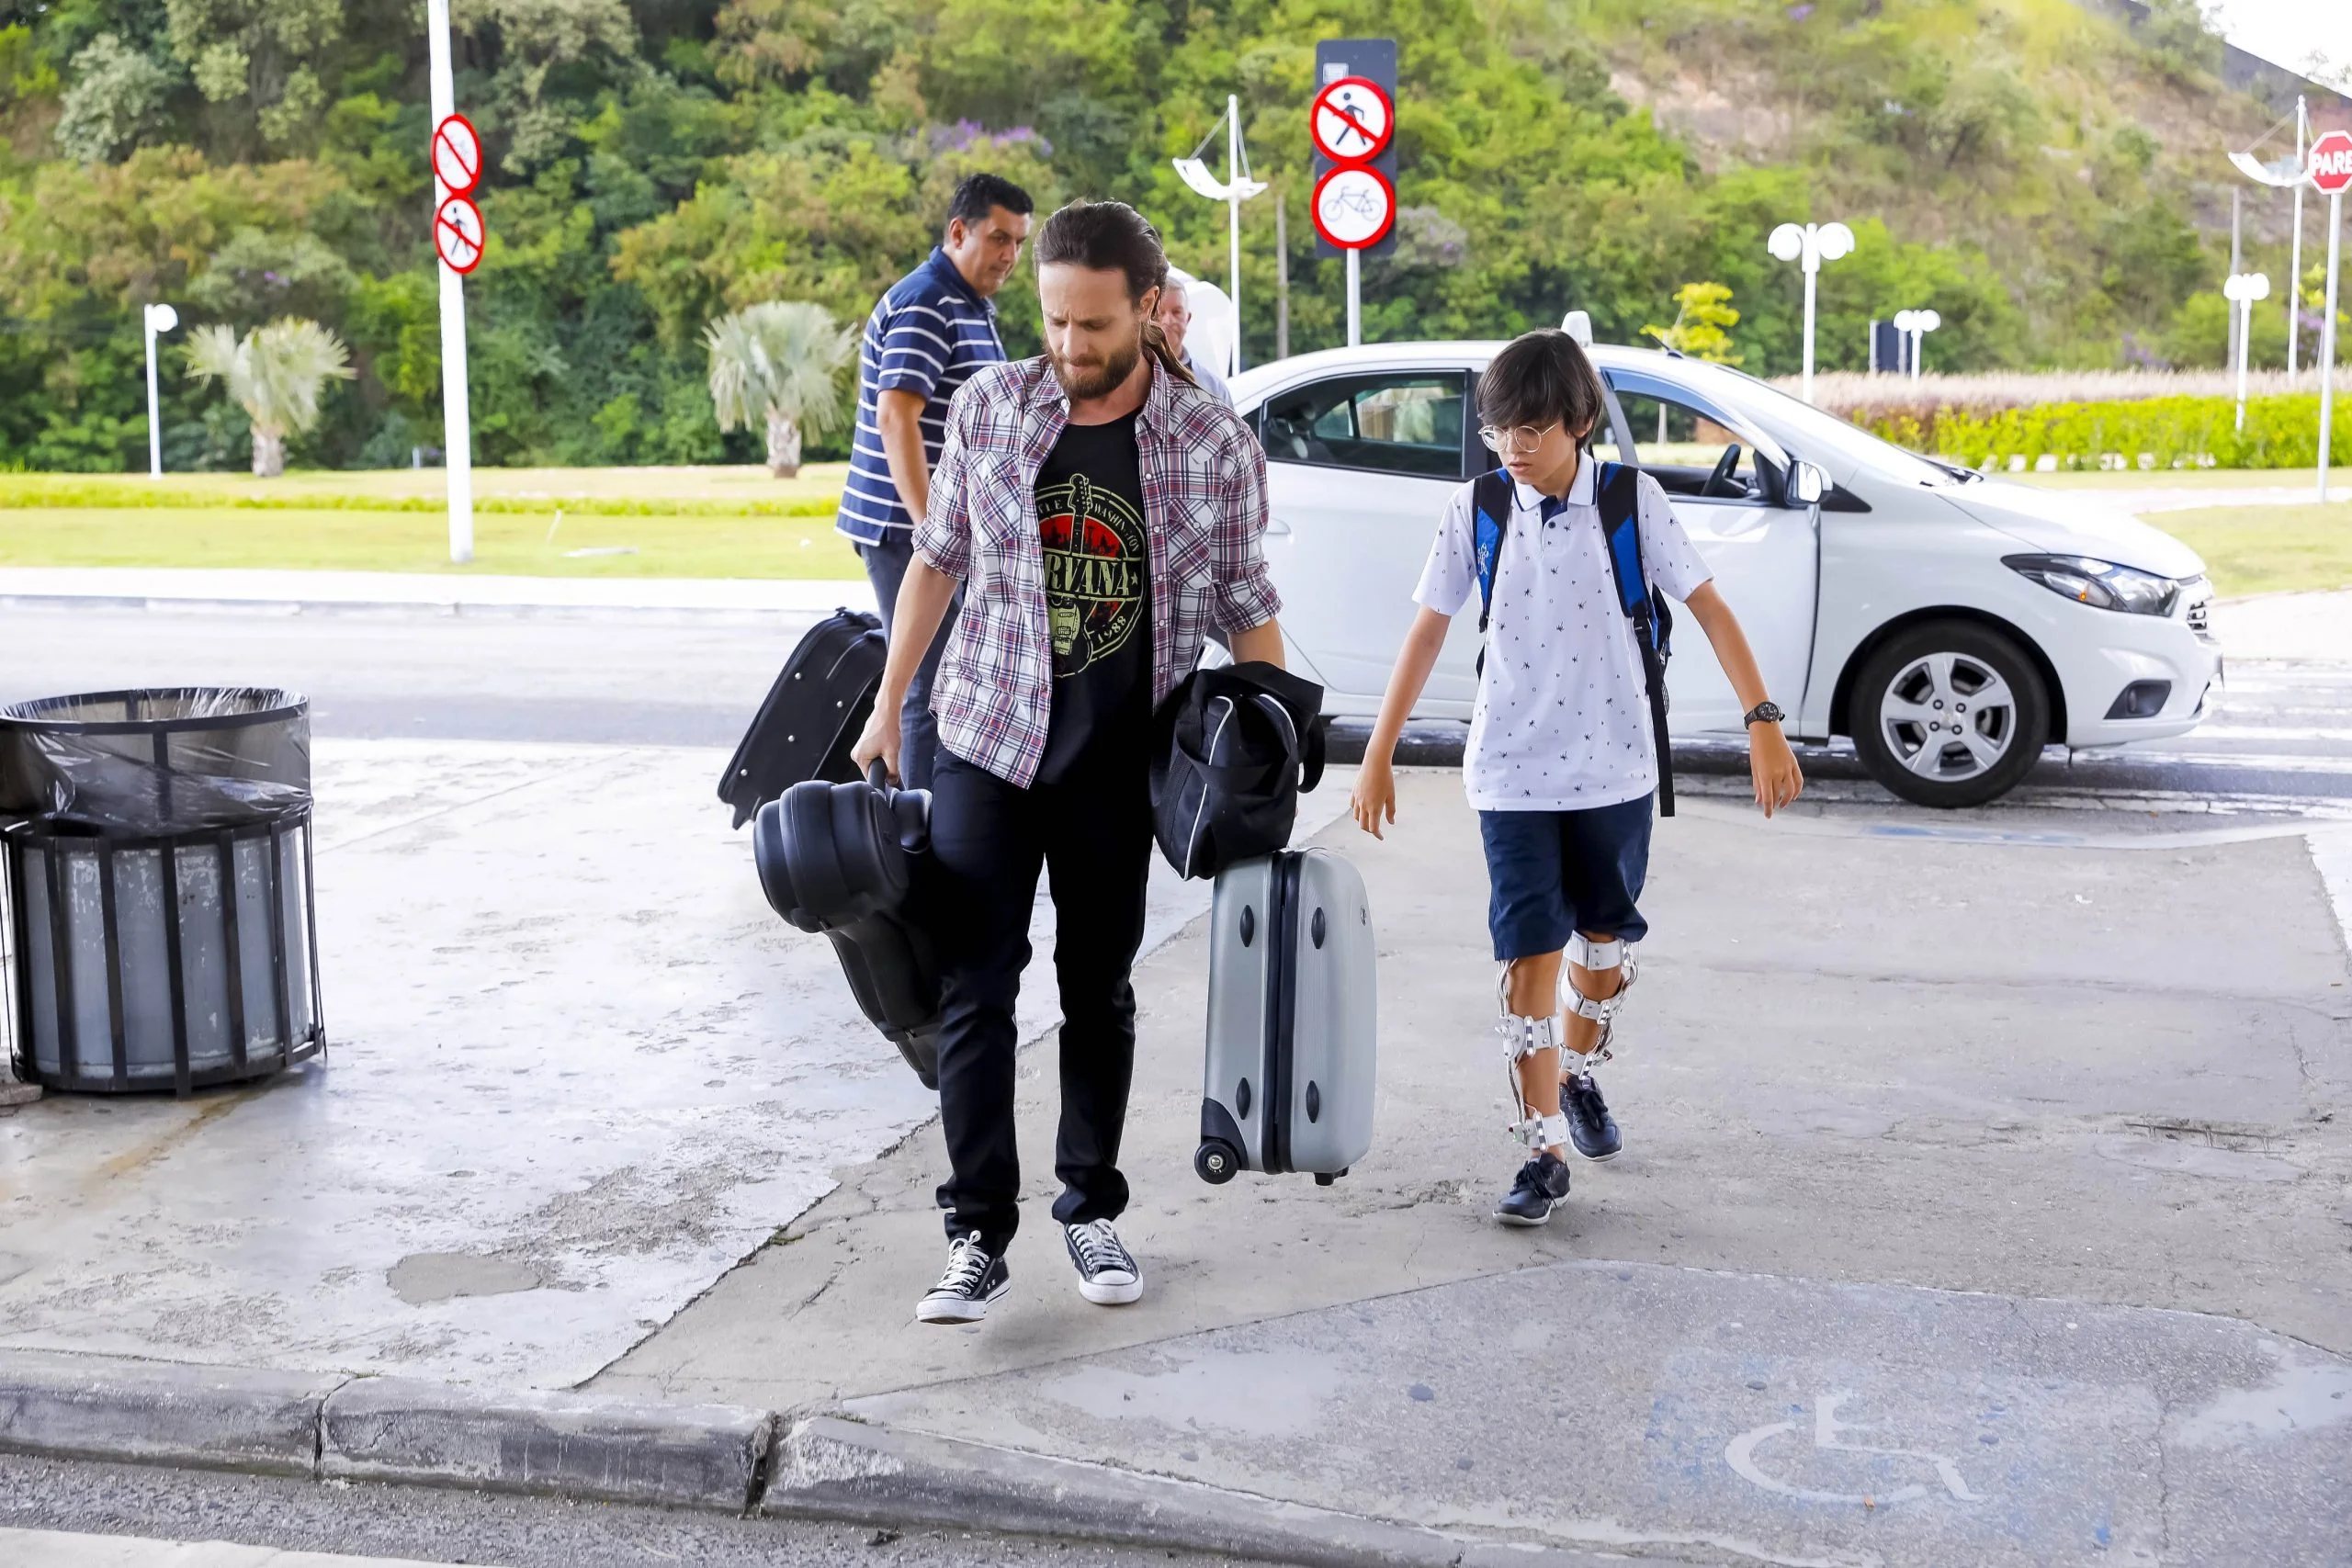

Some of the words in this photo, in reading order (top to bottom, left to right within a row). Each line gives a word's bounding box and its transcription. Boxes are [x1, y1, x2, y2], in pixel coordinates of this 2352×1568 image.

[2311, 150, 2352, 176] PARE
[1093, 502, 1140, 552] WASHINTON
[1044, 554, 1130, 596] RVANA
